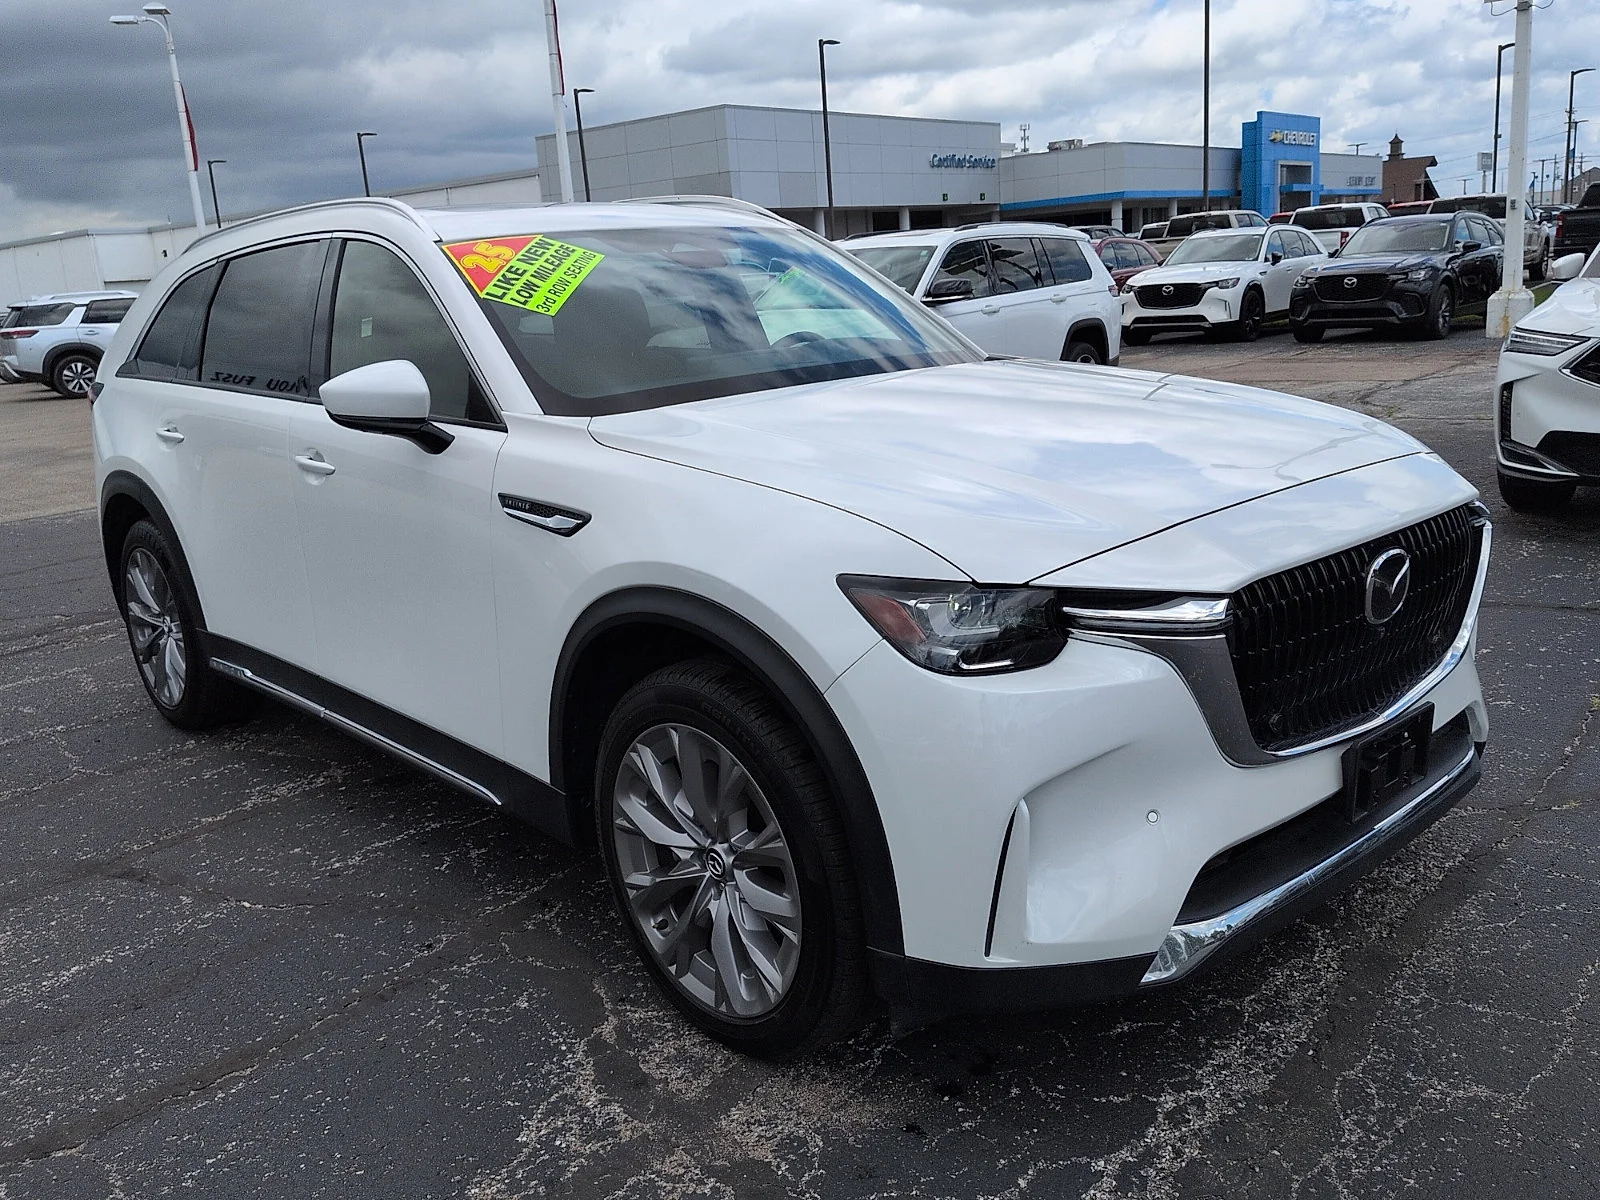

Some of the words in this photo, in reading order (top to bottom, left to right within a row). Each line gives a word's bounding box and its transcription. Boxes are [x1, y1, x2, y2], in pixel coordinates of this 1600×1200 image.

[460, 242, 515, 273] 25
[485, 265, 527, 300] LIKE
[516, 239, 555, 266] NEW
[510, 279, 541, 306] LOW
[531, 244, 575, 282] MILEAGE
[536, 296, 556, 312] 3rd
[548, 276, 572, 297] ROW
[564, 251, 597, 279] SEATING
